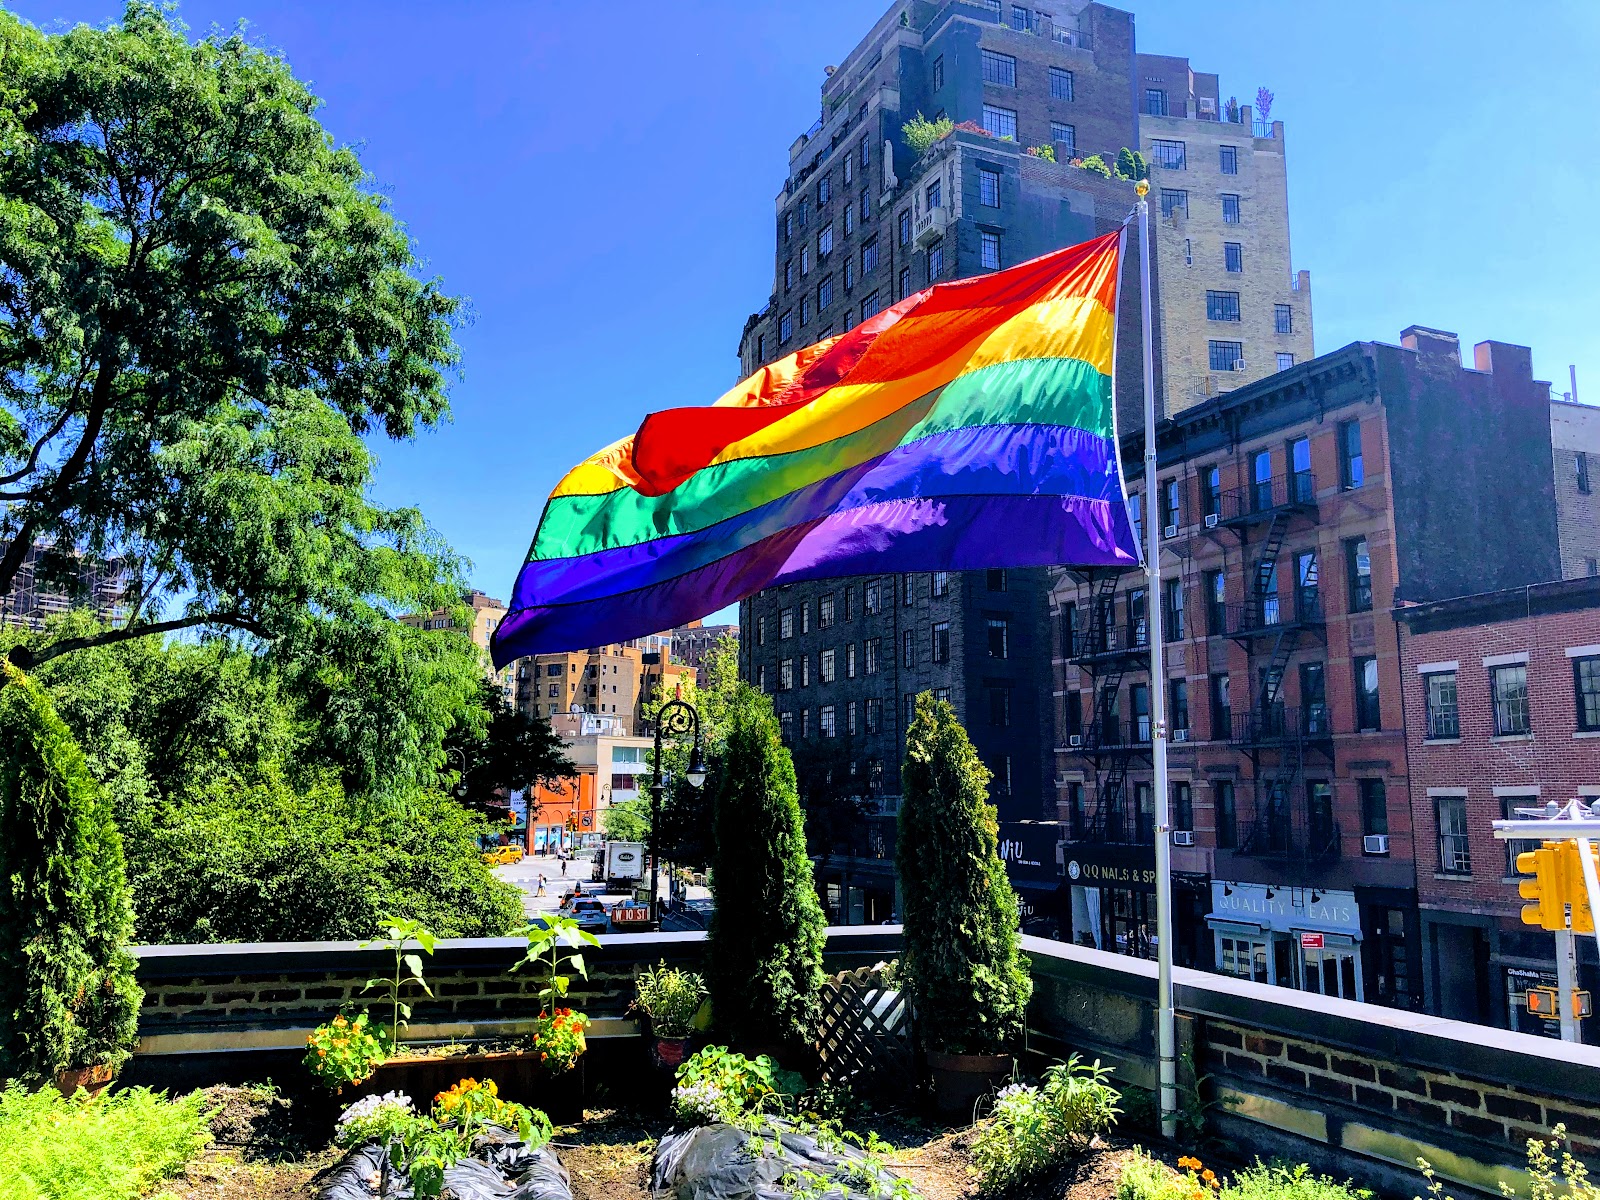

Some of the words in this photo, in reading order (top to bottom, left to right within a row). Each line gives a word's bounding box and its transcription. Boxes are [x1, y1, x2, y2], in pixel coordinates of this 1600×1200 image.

[1132, 869, 1140, 882] &
[1142, 870, 1156, 884] SP
[1219, 895, 1285, 915] QUALITY
[615, 909, 622, 920] W
[625, 908, 633, 920] 10
[637, 908, 646, 920] ST
